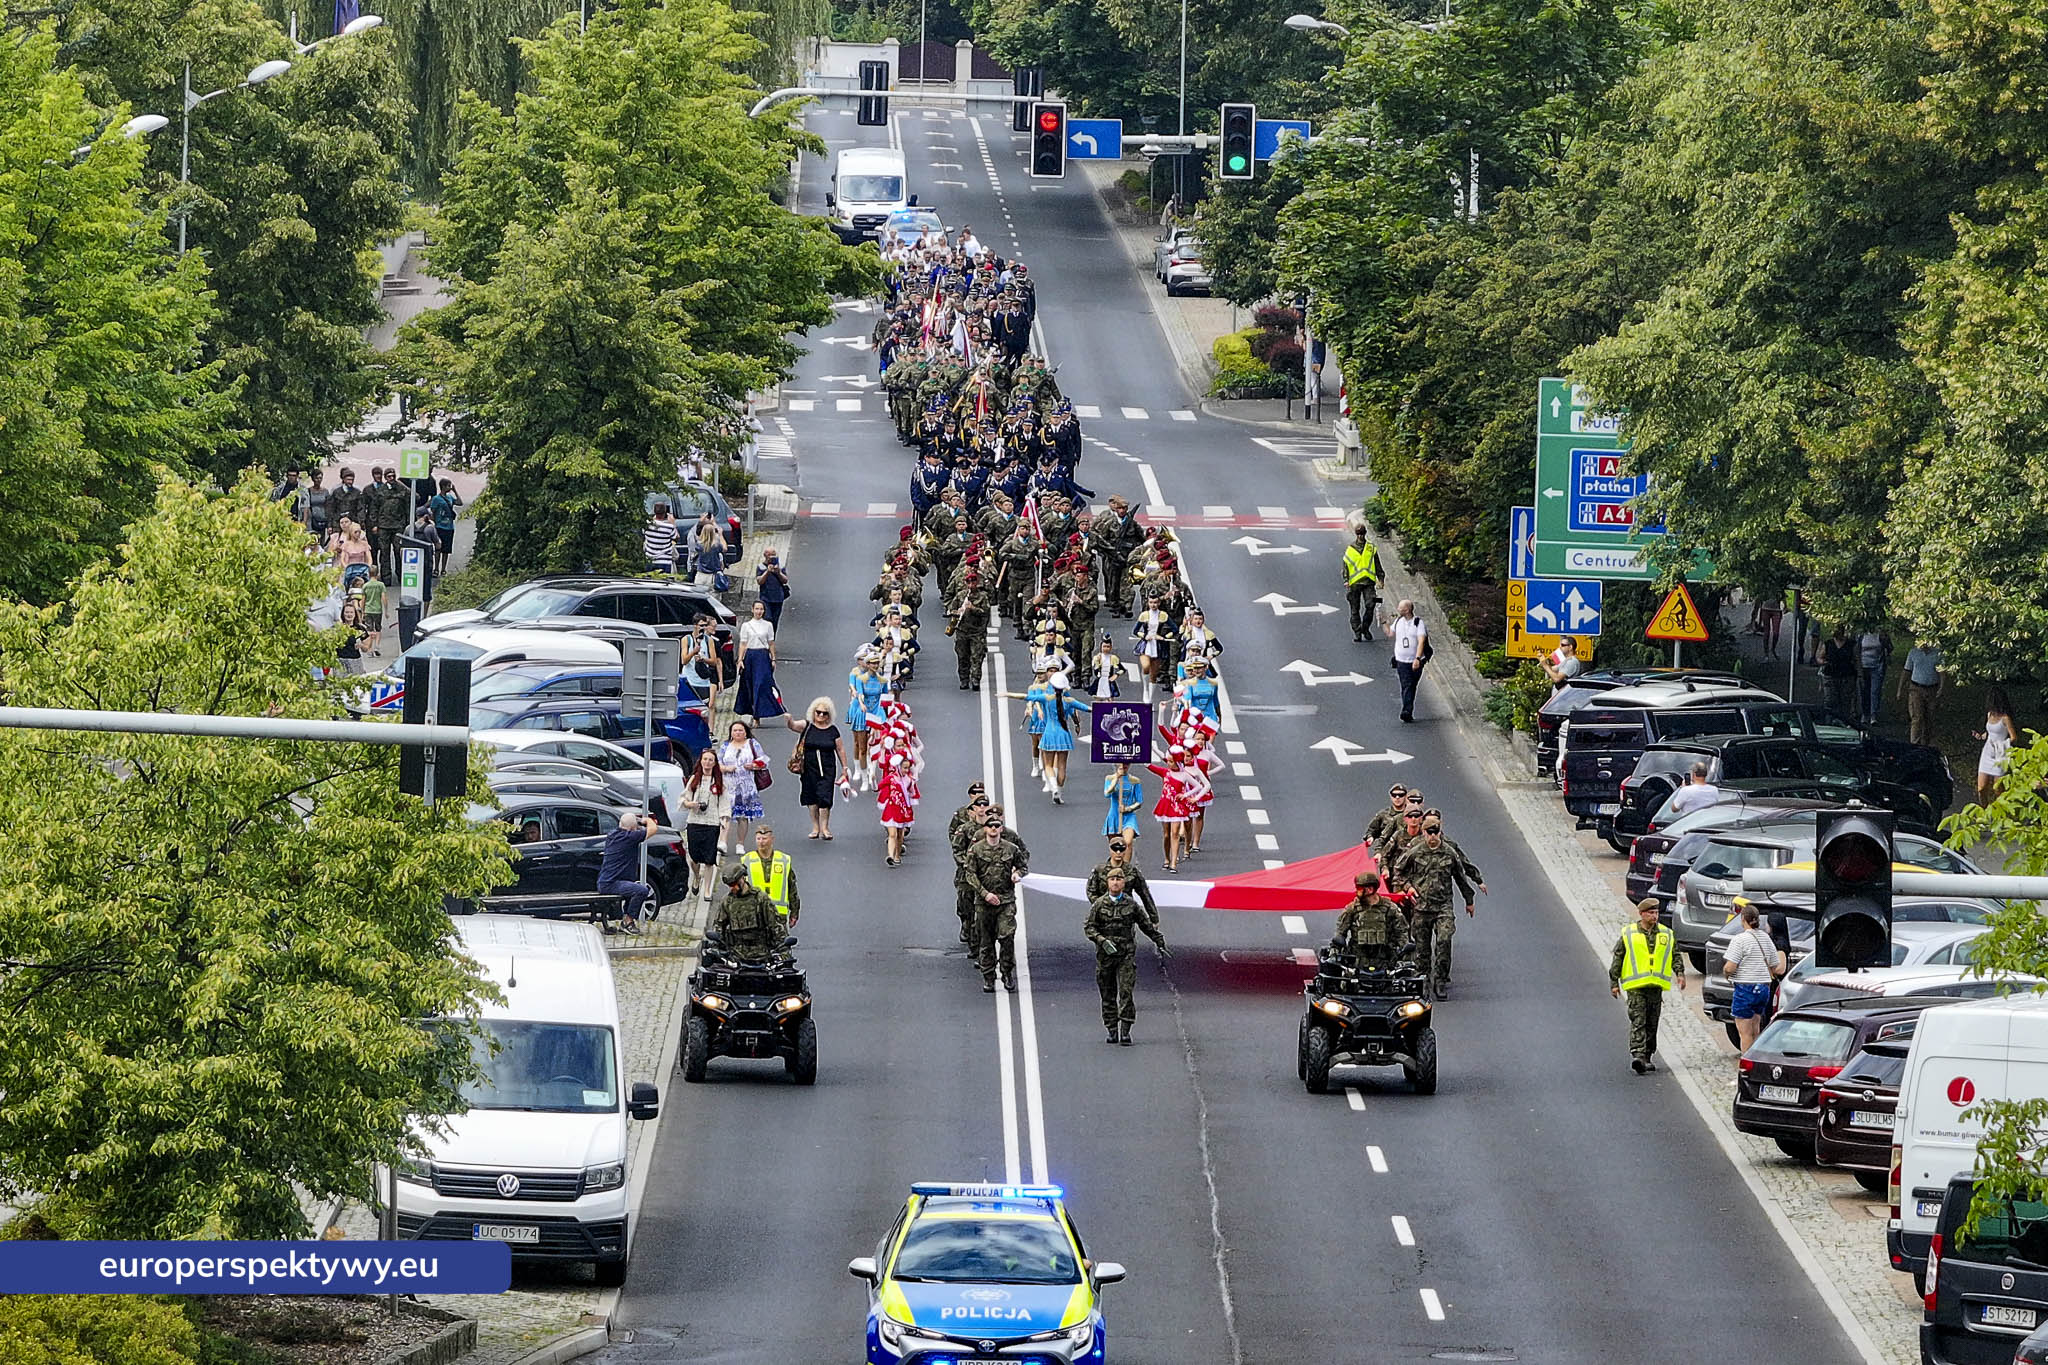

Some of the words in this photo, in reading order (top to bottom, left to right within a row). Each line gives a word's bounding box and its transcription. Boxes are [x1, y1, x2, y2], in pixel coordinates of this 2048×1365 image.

[407, 453, 422, 473] P
[1602, 506, 1627, 522] A4
[1509, 602, 1523, 612] do
[372, 683, 404, 707] TA
[960, 1187, 1000, 1197] POLICJA
[480, 1226, 498, 1238] UC
[501, 1227, 537, 1240] 05174
[940, 1306, 1032, 1321] POLICJA
[1988, 1306, 2002, 1319] ST
[2005, 1308, 2034, 1323] 5212J
